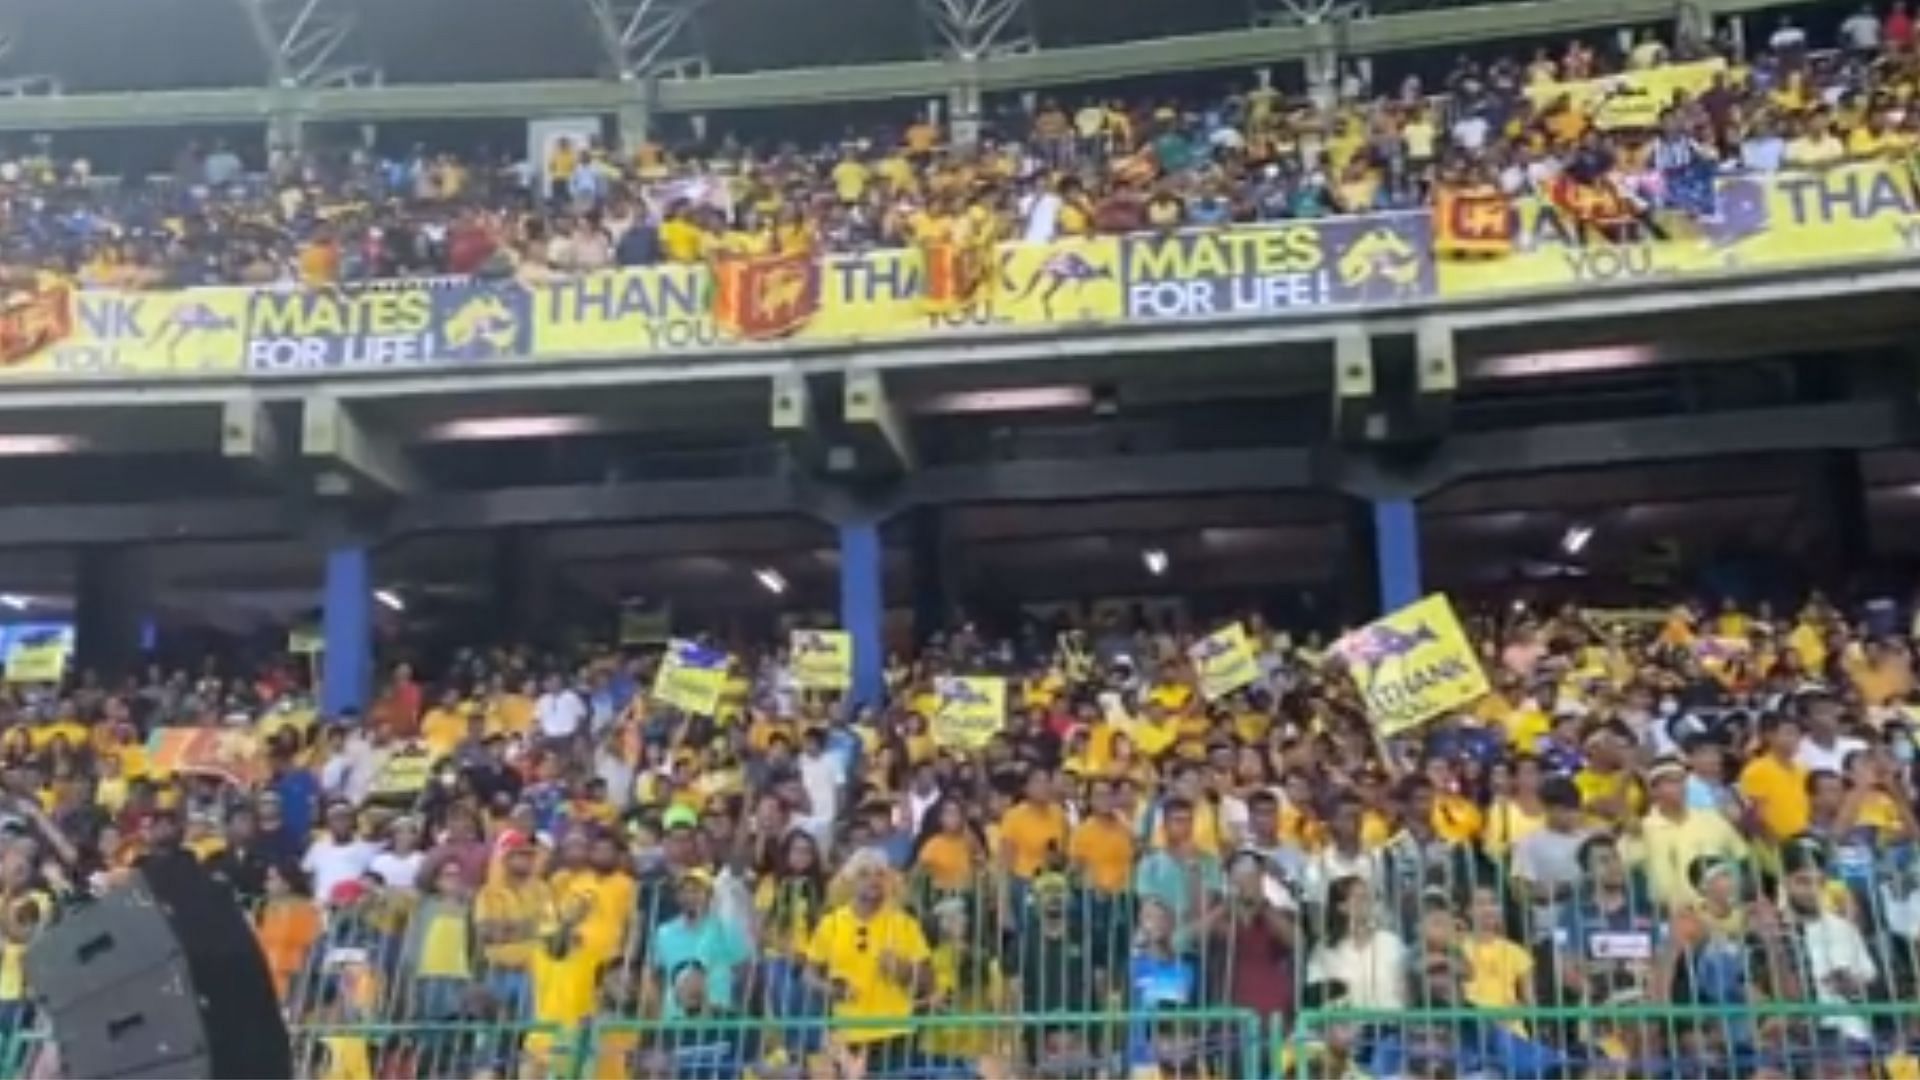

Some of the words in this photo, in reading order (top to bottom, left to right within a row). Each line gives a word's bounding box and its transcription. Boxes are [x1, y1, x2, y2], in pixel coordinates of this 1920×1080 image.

[1131, 226, 1323, 281] MATES
[252, 290, 430, 336] MATES
[549, 274, 697, 322] THAN
[1130, 281, 1214, 317] FOR
[1231, 270, 1330, 309] LIFE!
[250, 337, 328, 369] FOR
[344, 333, 434, 364] LIFE!
